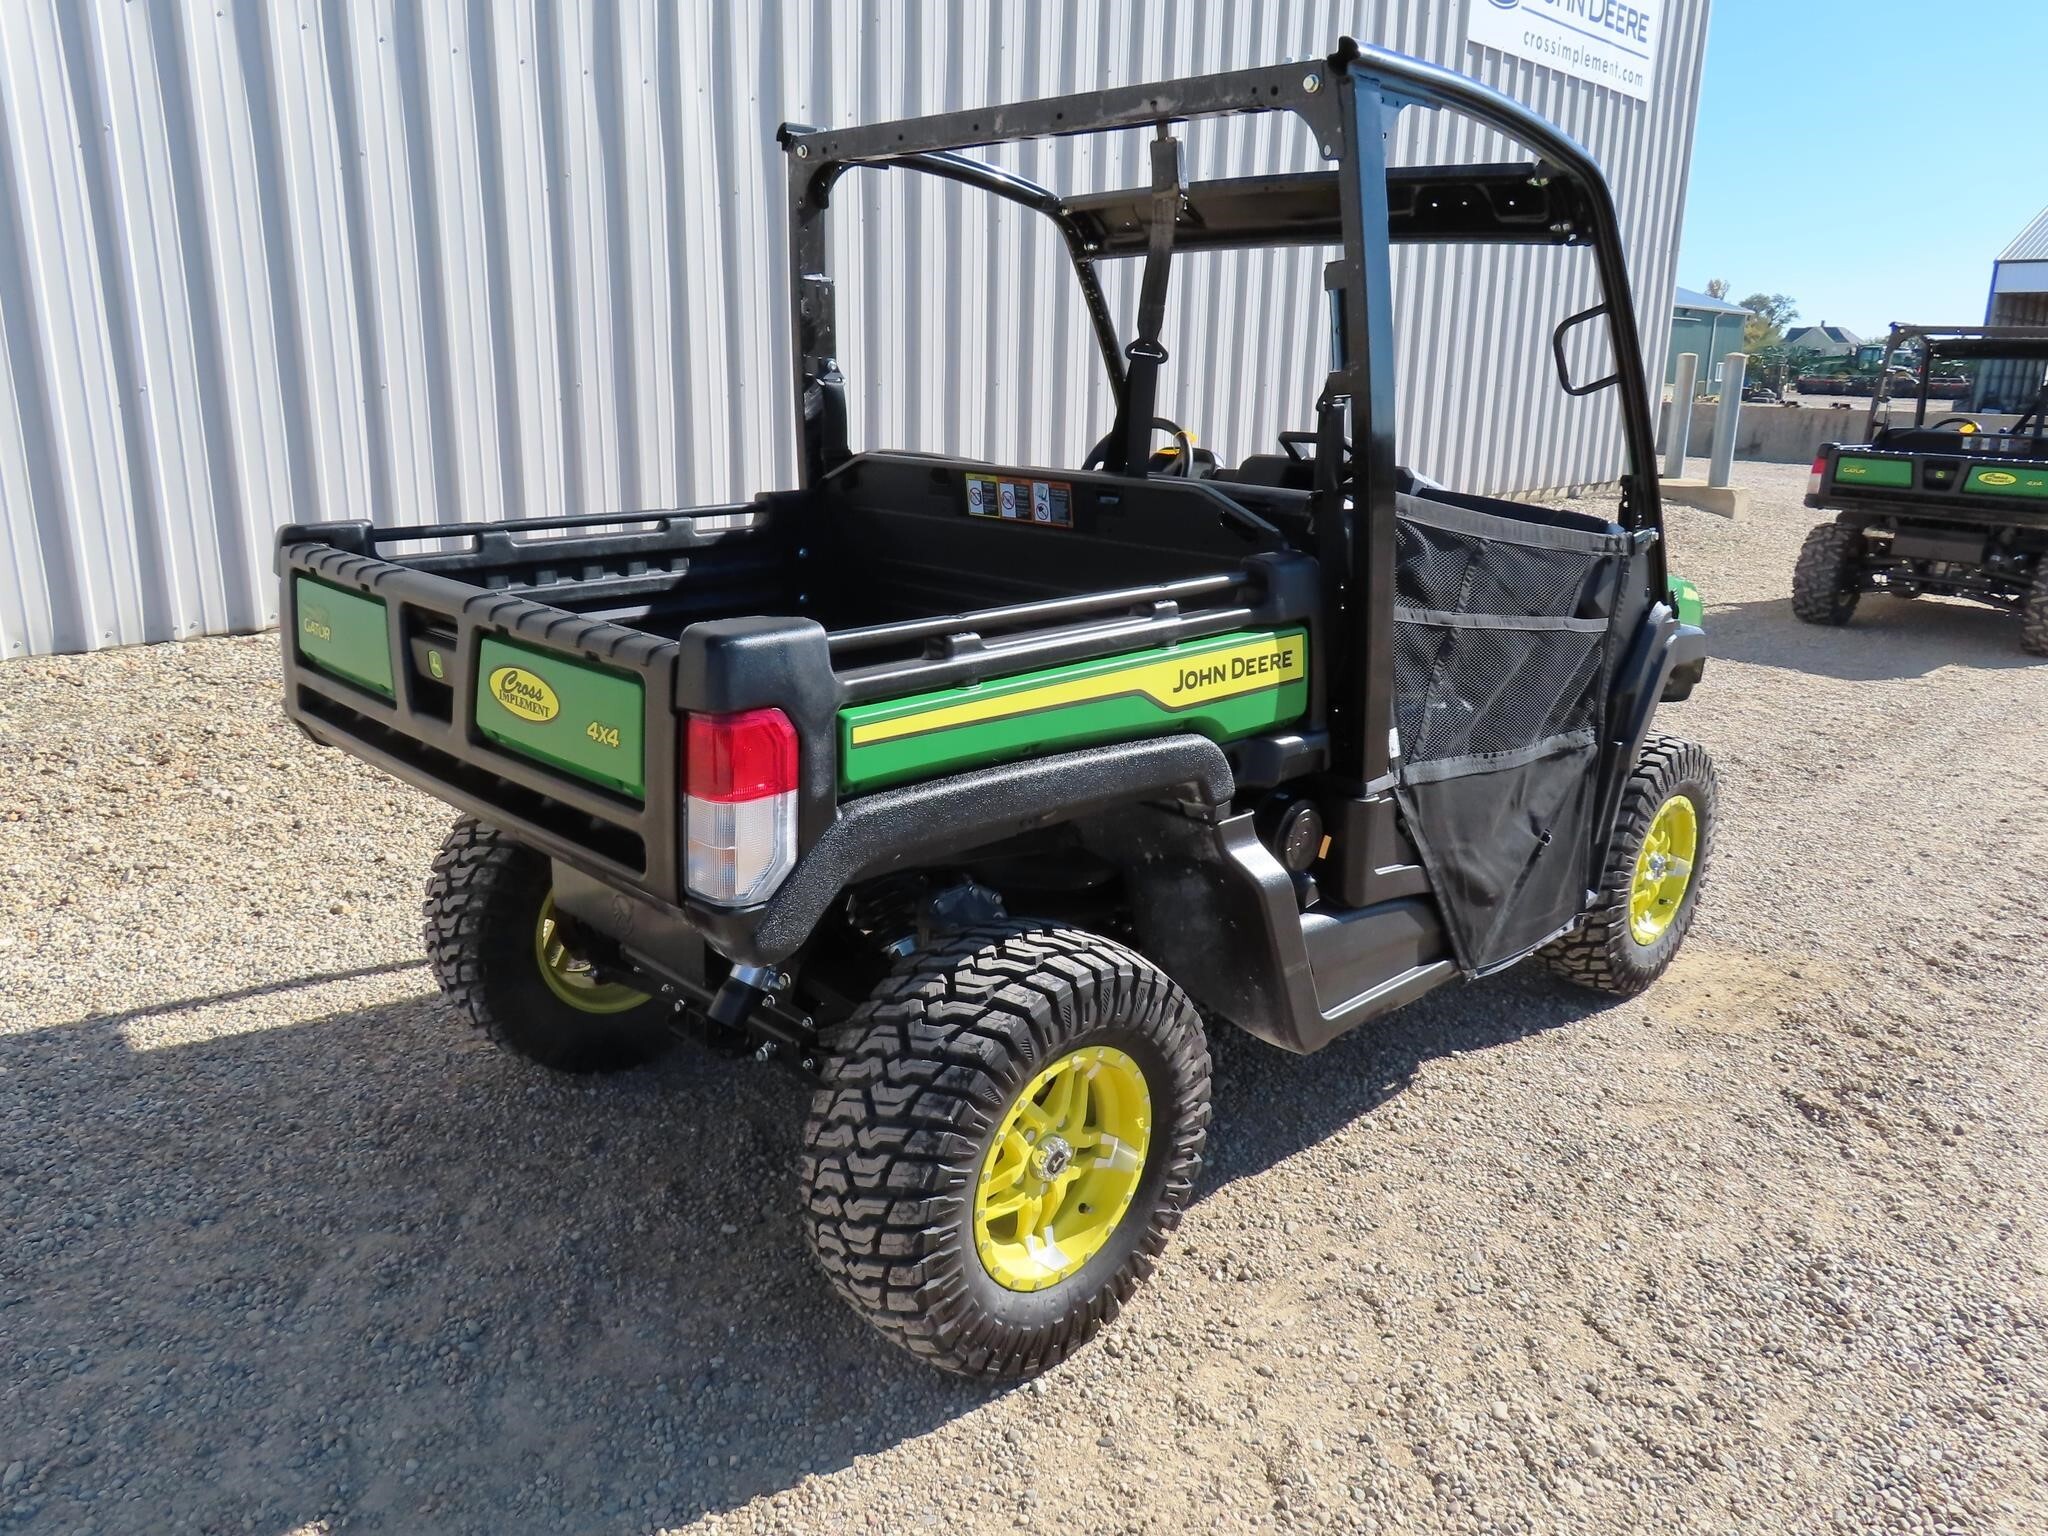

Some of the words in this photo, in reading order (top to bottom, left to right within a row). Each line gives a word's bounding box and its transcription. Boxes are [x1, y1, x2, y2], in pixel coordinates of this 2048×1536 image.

[1588, 0, 1650, 43] DEERE
[1523, 30, 1643, 87] crossimplement.com
[501, 670, 544, 701] Cross
[1172, 664, 1226, 693] JOHN
[1231, 650, 1293, 680] DEERE
[499, 689, 551, 718] IMPLEMENT
[586, 721, 620, 748] 4x4
